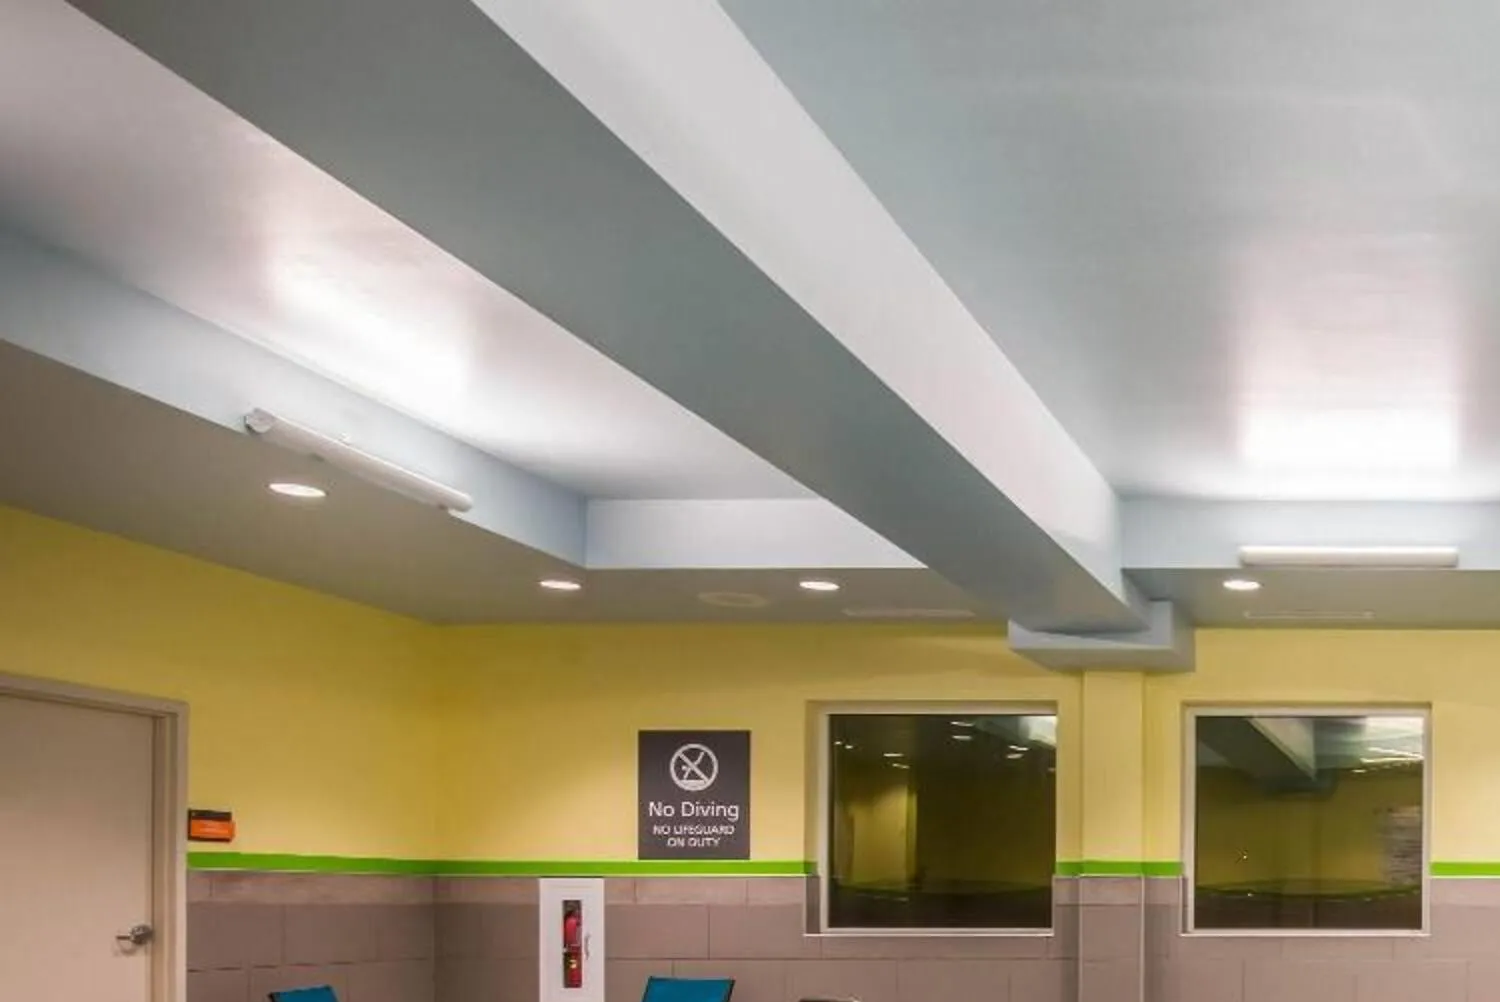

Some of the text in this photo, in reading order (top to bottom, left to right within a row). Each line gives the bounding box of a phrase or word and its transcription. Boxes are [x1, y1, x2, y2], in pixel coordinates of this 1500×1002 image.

[649, 801, 739, 822] No Diving
[653, 823, 735, 835] NO LIFEGUARD
[667, 837, 721, 847] ON DUTY
